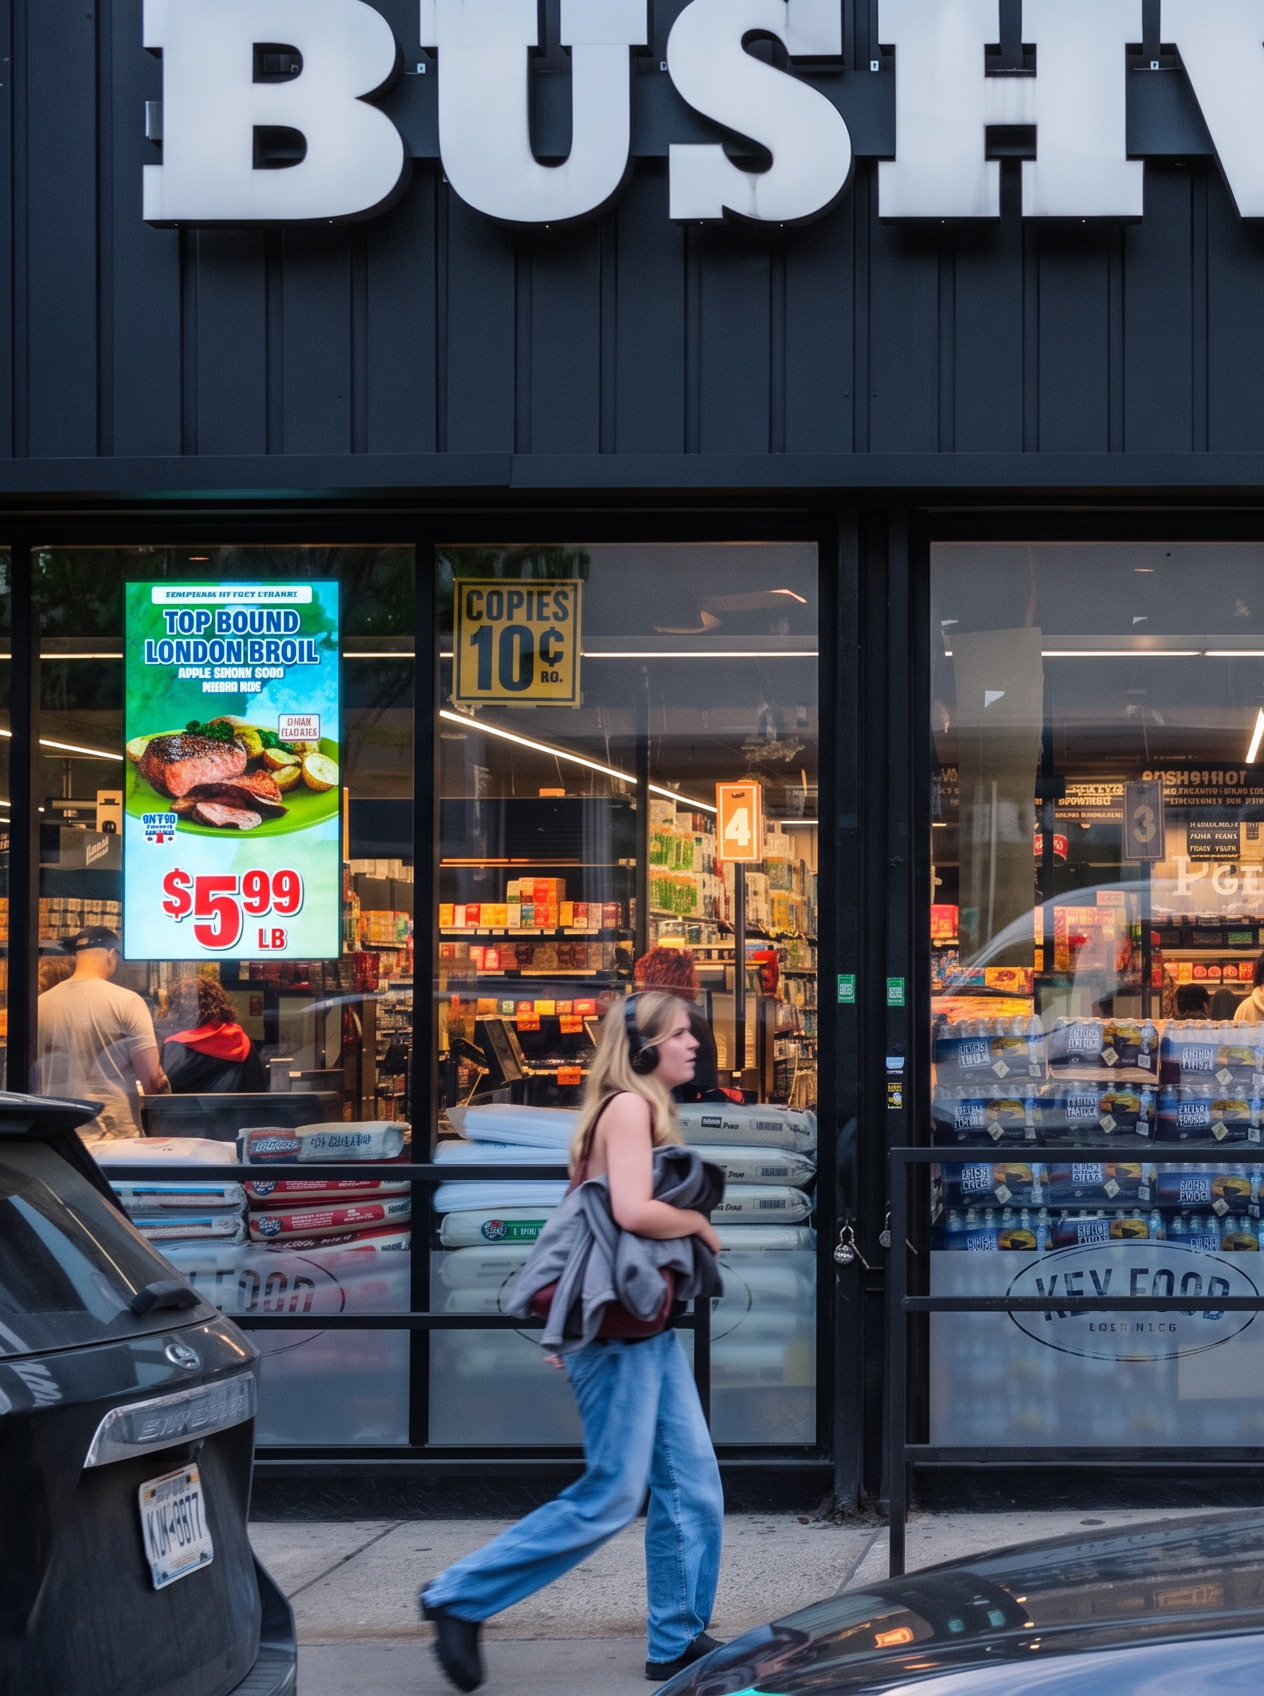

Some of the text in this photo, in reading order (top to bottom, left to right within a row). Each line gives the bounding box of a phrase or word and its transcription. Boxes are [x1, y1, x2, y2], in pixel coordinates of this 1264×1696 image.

[466, 590, 569, 622] COPIES
[164, 610, 299, 634] TOP BOUND
[145, 639, 319, 664] LONDON BROIL
[725, 808, 751, 846] 4
[1133, 805, 1156, 843] 3
[257, 928, 288, 950] LB
